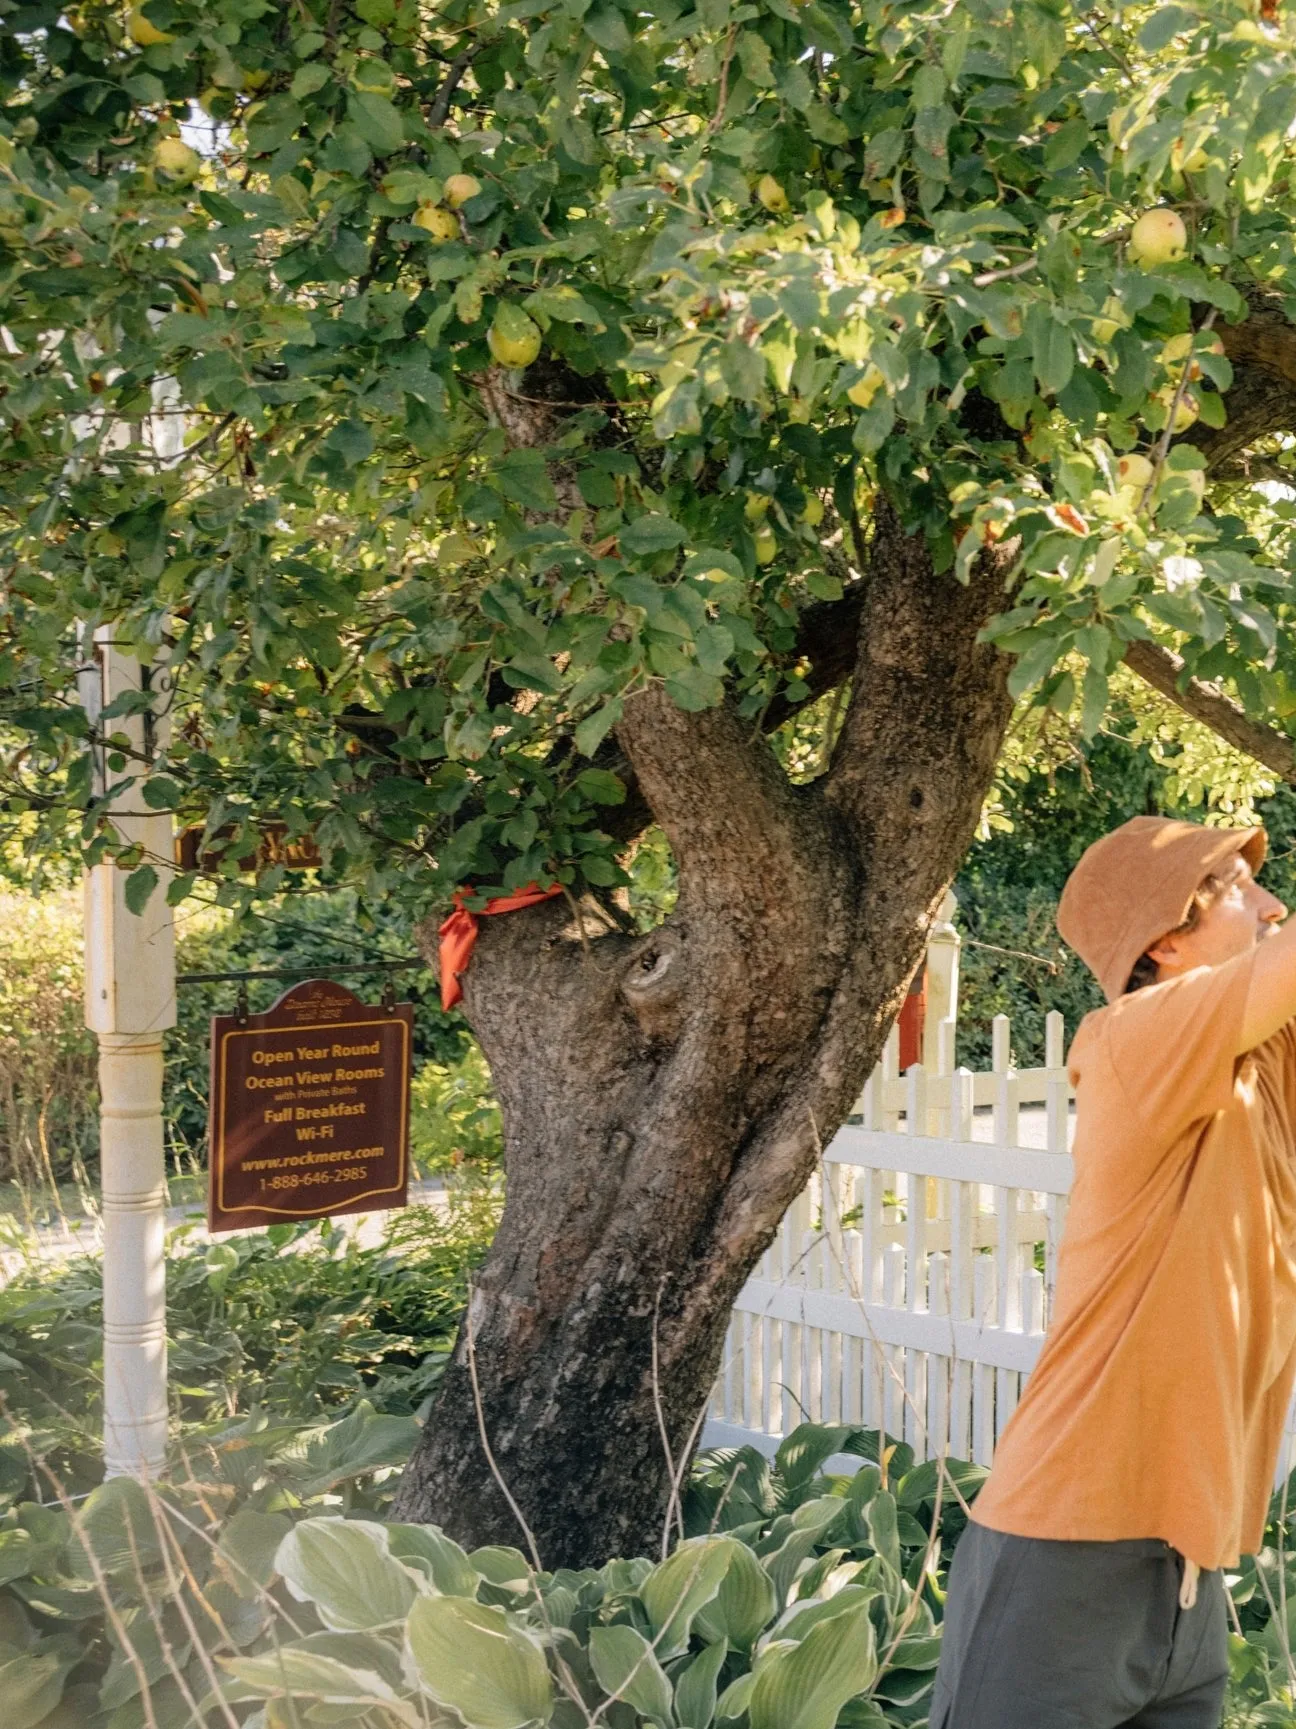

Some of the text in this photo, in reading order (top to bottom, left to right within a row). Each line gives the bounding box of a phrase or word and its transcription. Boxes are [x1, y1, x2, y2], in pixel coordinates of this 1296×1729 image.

[252, 1041, 380, 1066] Open Year Round
[245, 1067, 385, 1089] Ocean View Rooms
[274, 1086, 357, 1101] with Private Baths
[264, 1102, 366, 1123] Full Breakfast
[296, 1124, 334, 1141] Wi-Fi
[242, 1147, 384, 1171] www.rockmere.com
[259, 1166, 367, 1191] 1-888-646-2985
